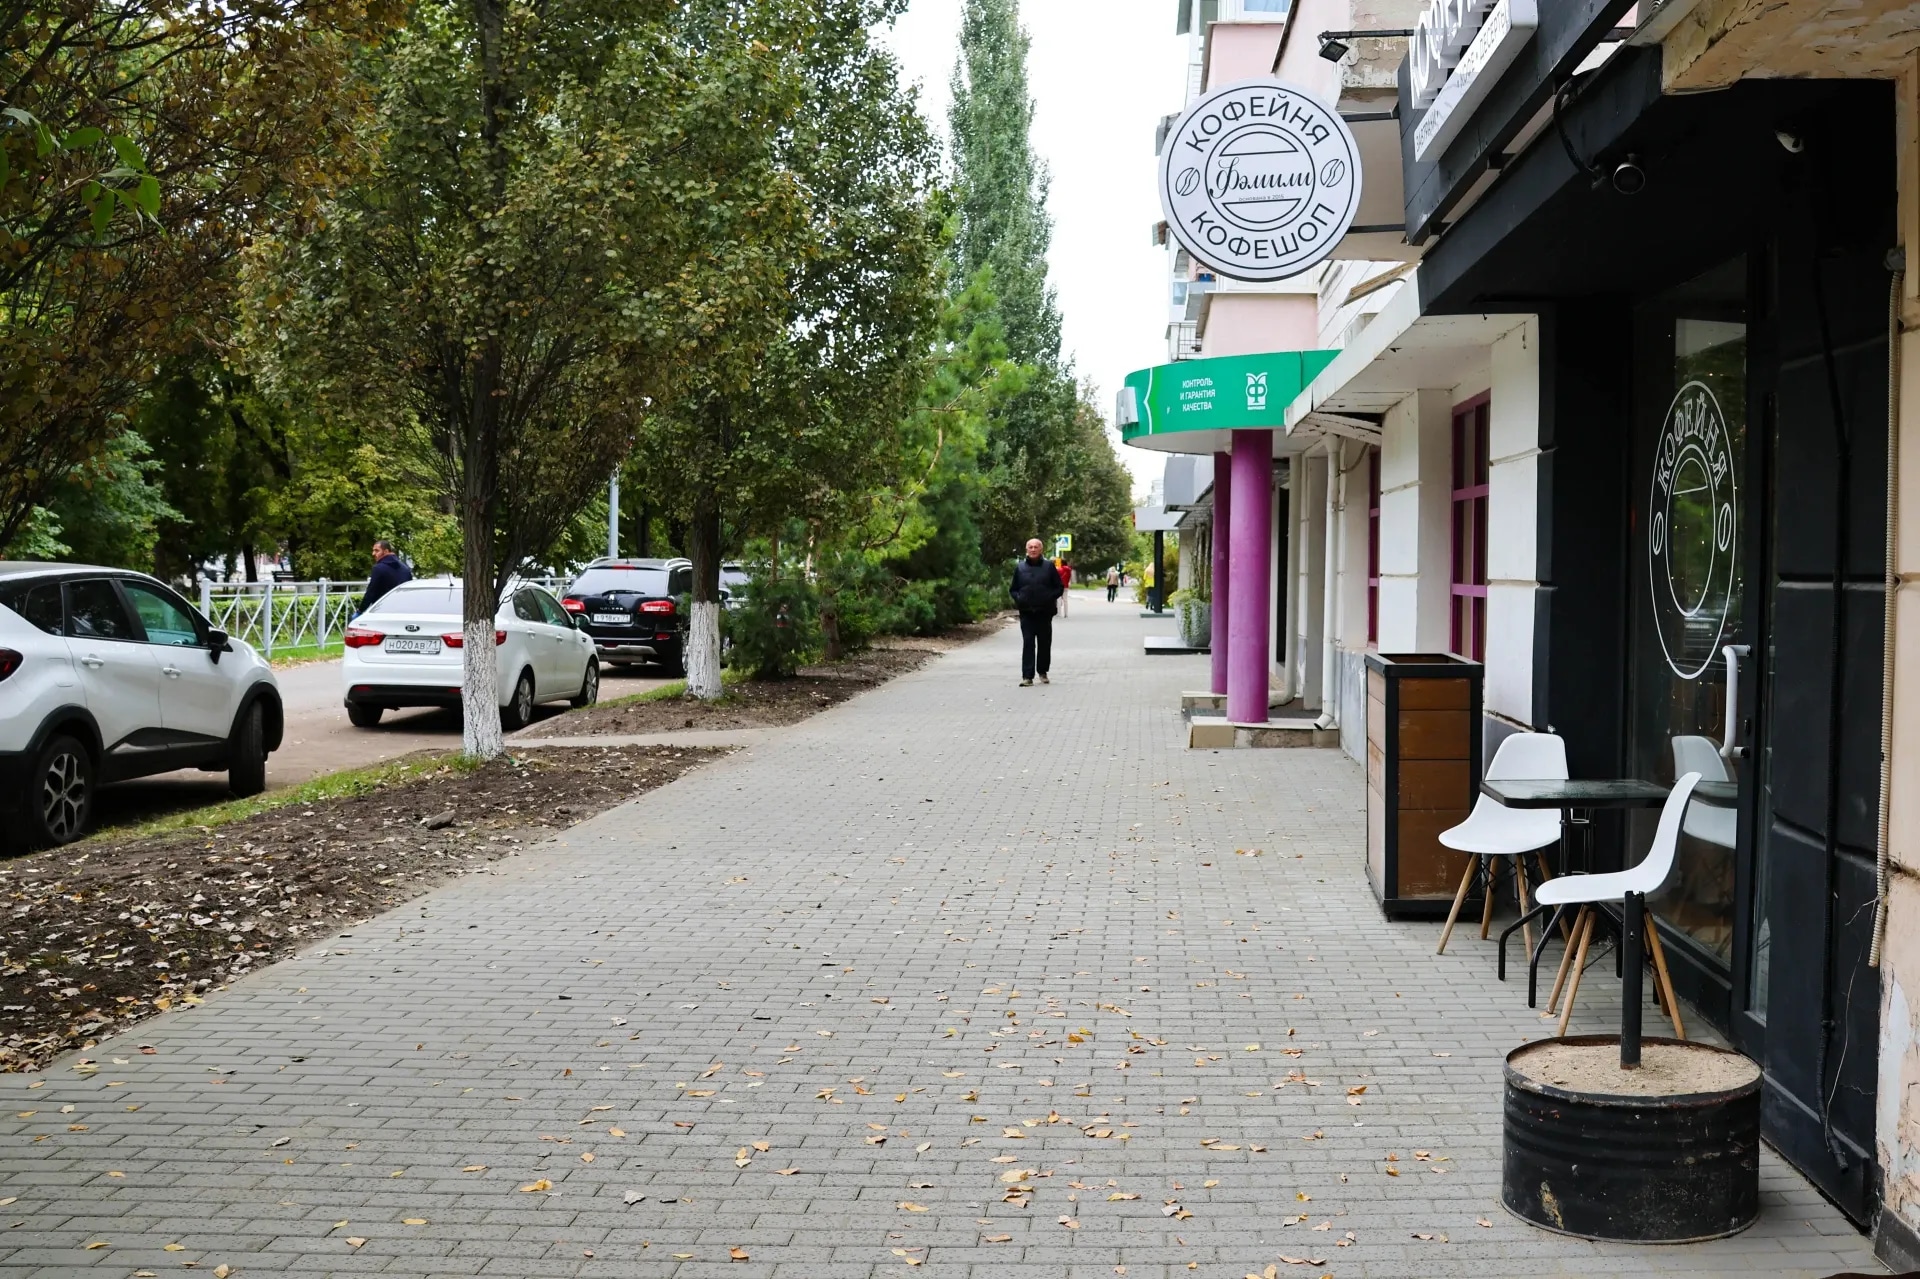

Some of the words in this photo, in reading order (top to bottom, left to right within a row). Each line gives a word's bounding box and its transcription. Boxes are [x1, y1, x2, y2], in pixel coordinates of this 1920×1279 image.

[1185, 93, 1330, 153] КОФЕЙНЯ
[1209, 156, 1312, 199] Фэмили
[1191, 202, 1335, 260] КОФЕШОП
[1180, 392, 1184, 400] И
[1185, 389, 1216, 399] ГАРАНТИЯ
[1182, 378, 1213, 388] КОНТРОЛЬ
[1182, 402, 1212, 412] КАЧЕСТВА
[1658, 391, 1728, 497] КОФЕЙНЯ
